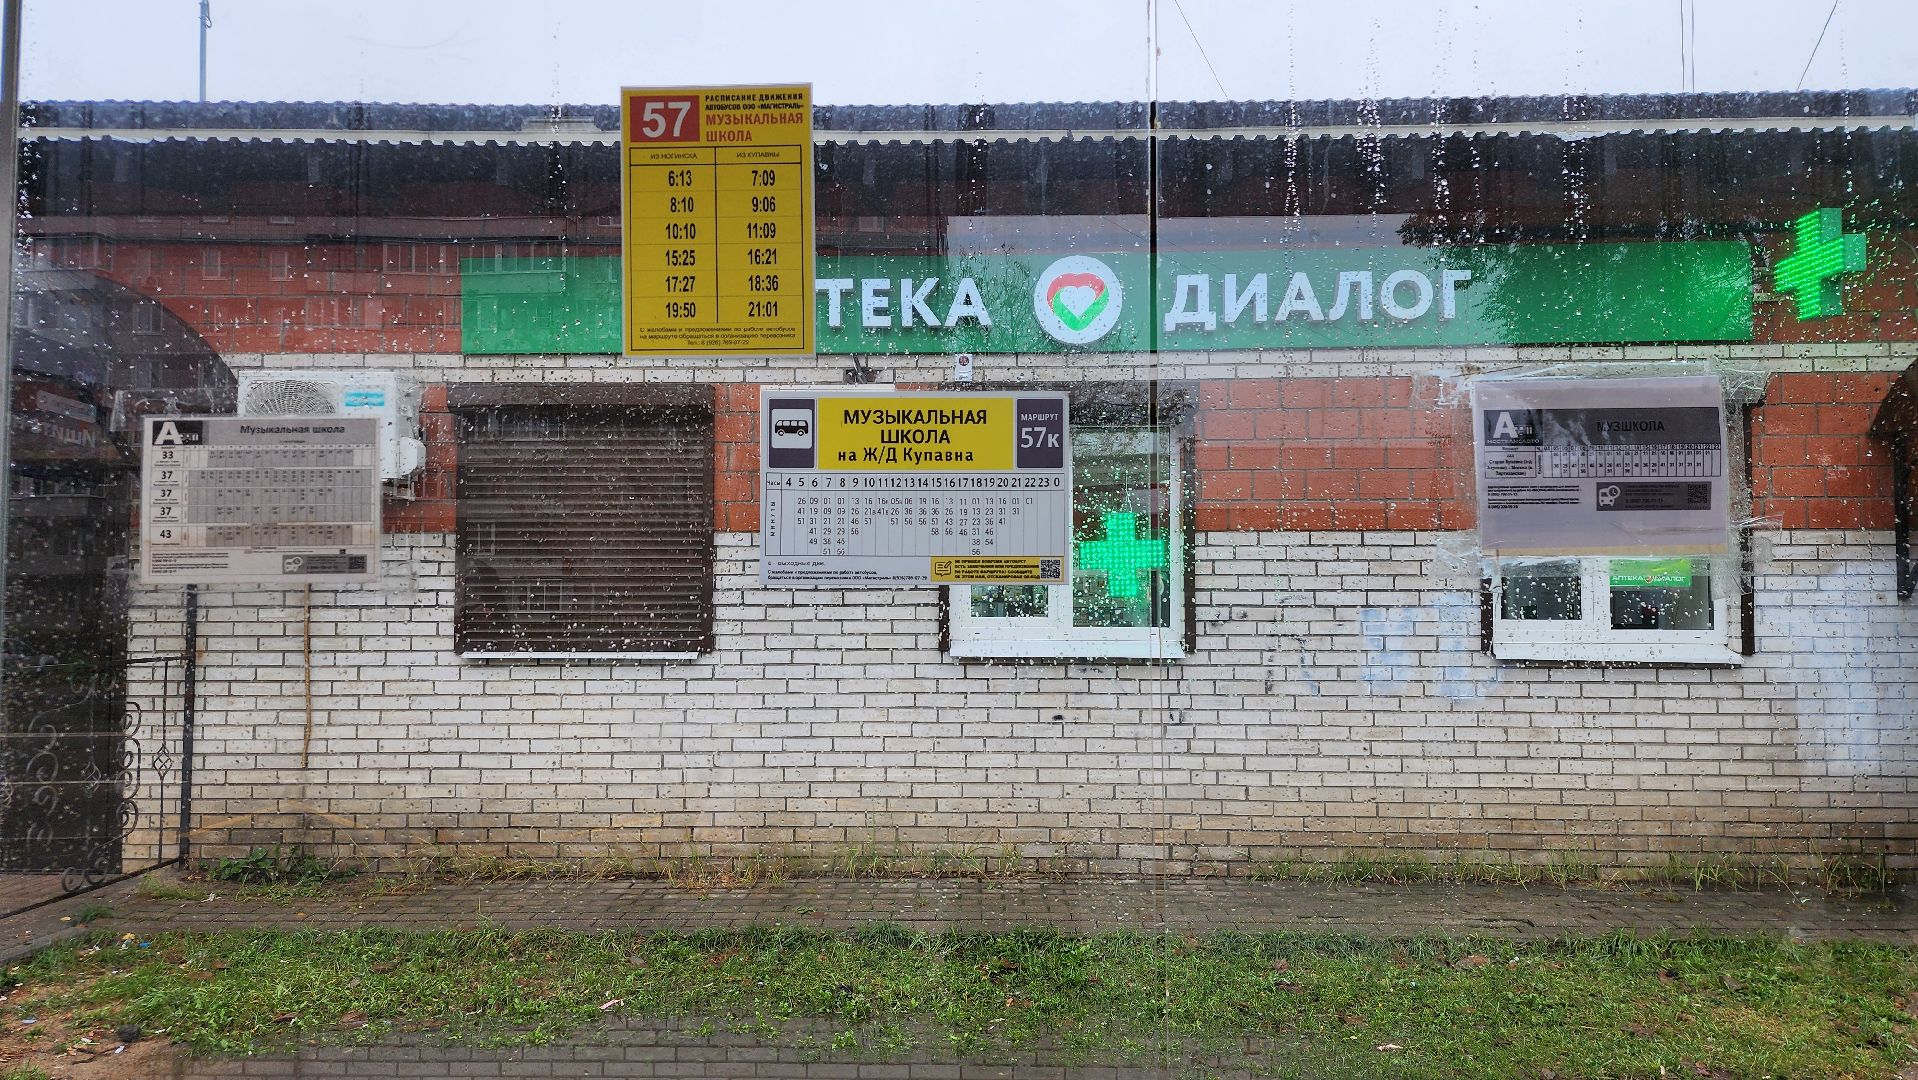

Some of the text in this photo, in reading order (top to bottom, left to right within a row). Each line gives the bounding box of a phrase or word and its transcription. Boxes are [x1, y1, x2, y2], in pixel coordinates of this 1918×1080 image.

[705, 93, 803, 102] РАСПИСАНИЕ ДВИЖЕНИЯ
[642, 101, 691, 138] 57
[705, 112, 804, 126] МУЗЫКАЛЬНАЯ
[706, 130, 753, 142] ШКОЛА
[668, 170, 776, 187] 6:13 7:09
[670, 196, 776, 213] 8:10 9:06
[665, 222, 776, 240] 10:10 11:09
[665, 248, 777, 266] 15:25 16:21
[666, 275, 778, 292] 17:27 18:36
[815, 269, 1472, 333] ТЕКА ДИАЛОГ
[666, 301, 778, 318] 19:50 21:01
[843, 409, 987, 425] МУЗЫКАЛЬНАЯ
[240, 425, 310, 435] Музыкальная
[1597, 420, 1665, 432] МУЗШКОЛА
[880, 429, 951, 444] ШКОЛА
[1020, 426, 1060, 448] 57к
[162, 451, 174, 459] 33
[838, 446, 974, 466] на Ж/Д Купавна
[160, 471, 172, 480] 37
[786, 478, 792, 487] 4
[798, 478, 804, 487] 5
[812, 478, 818, 487] 6
[826, 478, 832, 487] 7
[840, 478, 846, 487] 8
[852, 478, 858, 487] 9
[864, 478, 875, 487] 10
[878, 478, 888, 487] 11
[890, 478, 902, 487] 12
[904, 478, 915, 487] 13
[918, 478, 928, 487] 14
[932, 478, 942, 487] 15
[944, 478, 956, 487] 16
[958, 478, 968, 487] 17
[971, 478, 982, 487] 18
[984, 478, 995, 487] 19
[997, 478, 1009, 487] 20
[1011, 478, 1021, 487] 21
[1024, 478, 1036, 487] 22
[1038, 478, 1050, 487] 23
[1054, 478, 1060, 487] 0
[160, 489, 172, 497] 37
[160, 507, 172, 516] 37
[160, 530, 172, 538] 43
